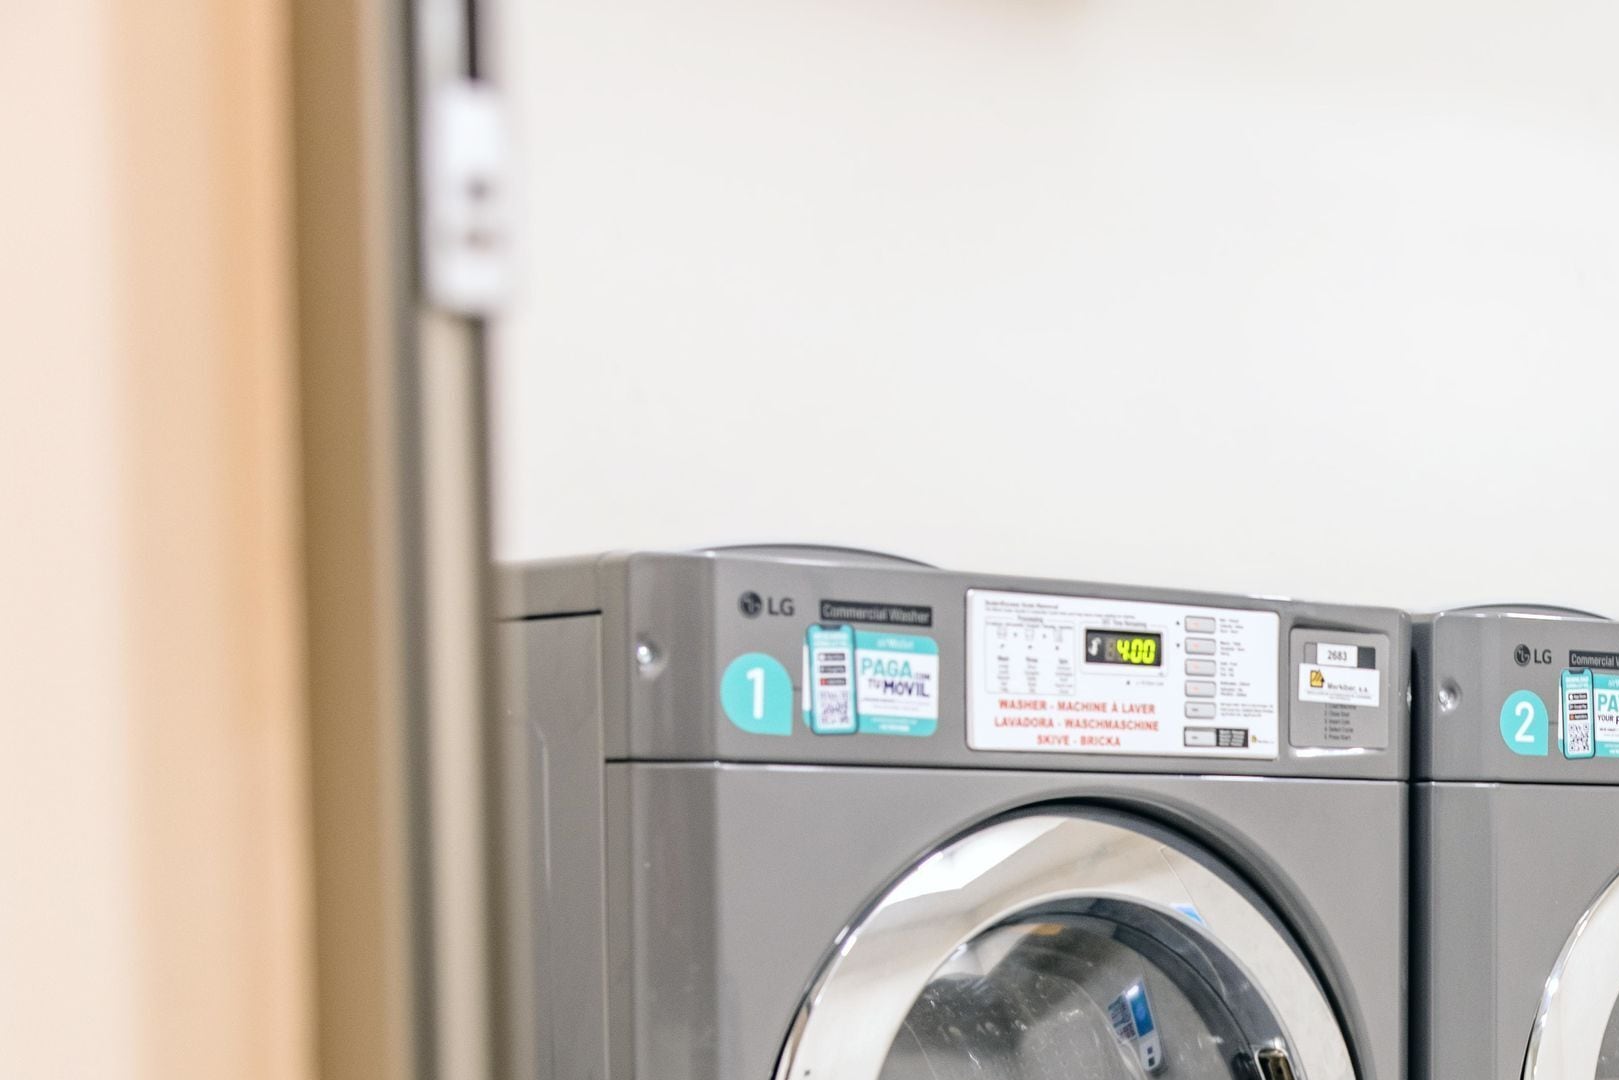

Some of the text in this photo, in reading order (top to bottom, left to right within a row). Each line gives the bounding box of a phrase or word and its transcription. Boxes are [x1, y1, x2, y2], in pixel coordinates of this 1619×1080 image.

[767, 597, 795, 616] LG
[822, 603, 931, 624] Commercial Washer
[1534, 649, 1552, 664] LG
[1571, 653, 1614, 666] Commercial
[861, 657, 913, 678] PAGA
[746, 666, 765, 720] 1
[998, 699, 1047, 711] WASHER
[1057, 701, 1108, 713] MACHINE
[1121, 703, 1156, 715] LAVER
[994, 717, 1159, 731] LAVADORA WASCHMASCHINE
[1514, 700, 1535, 743] 2
[1037, 734, 1121, 747] SKIVE BRICKA
